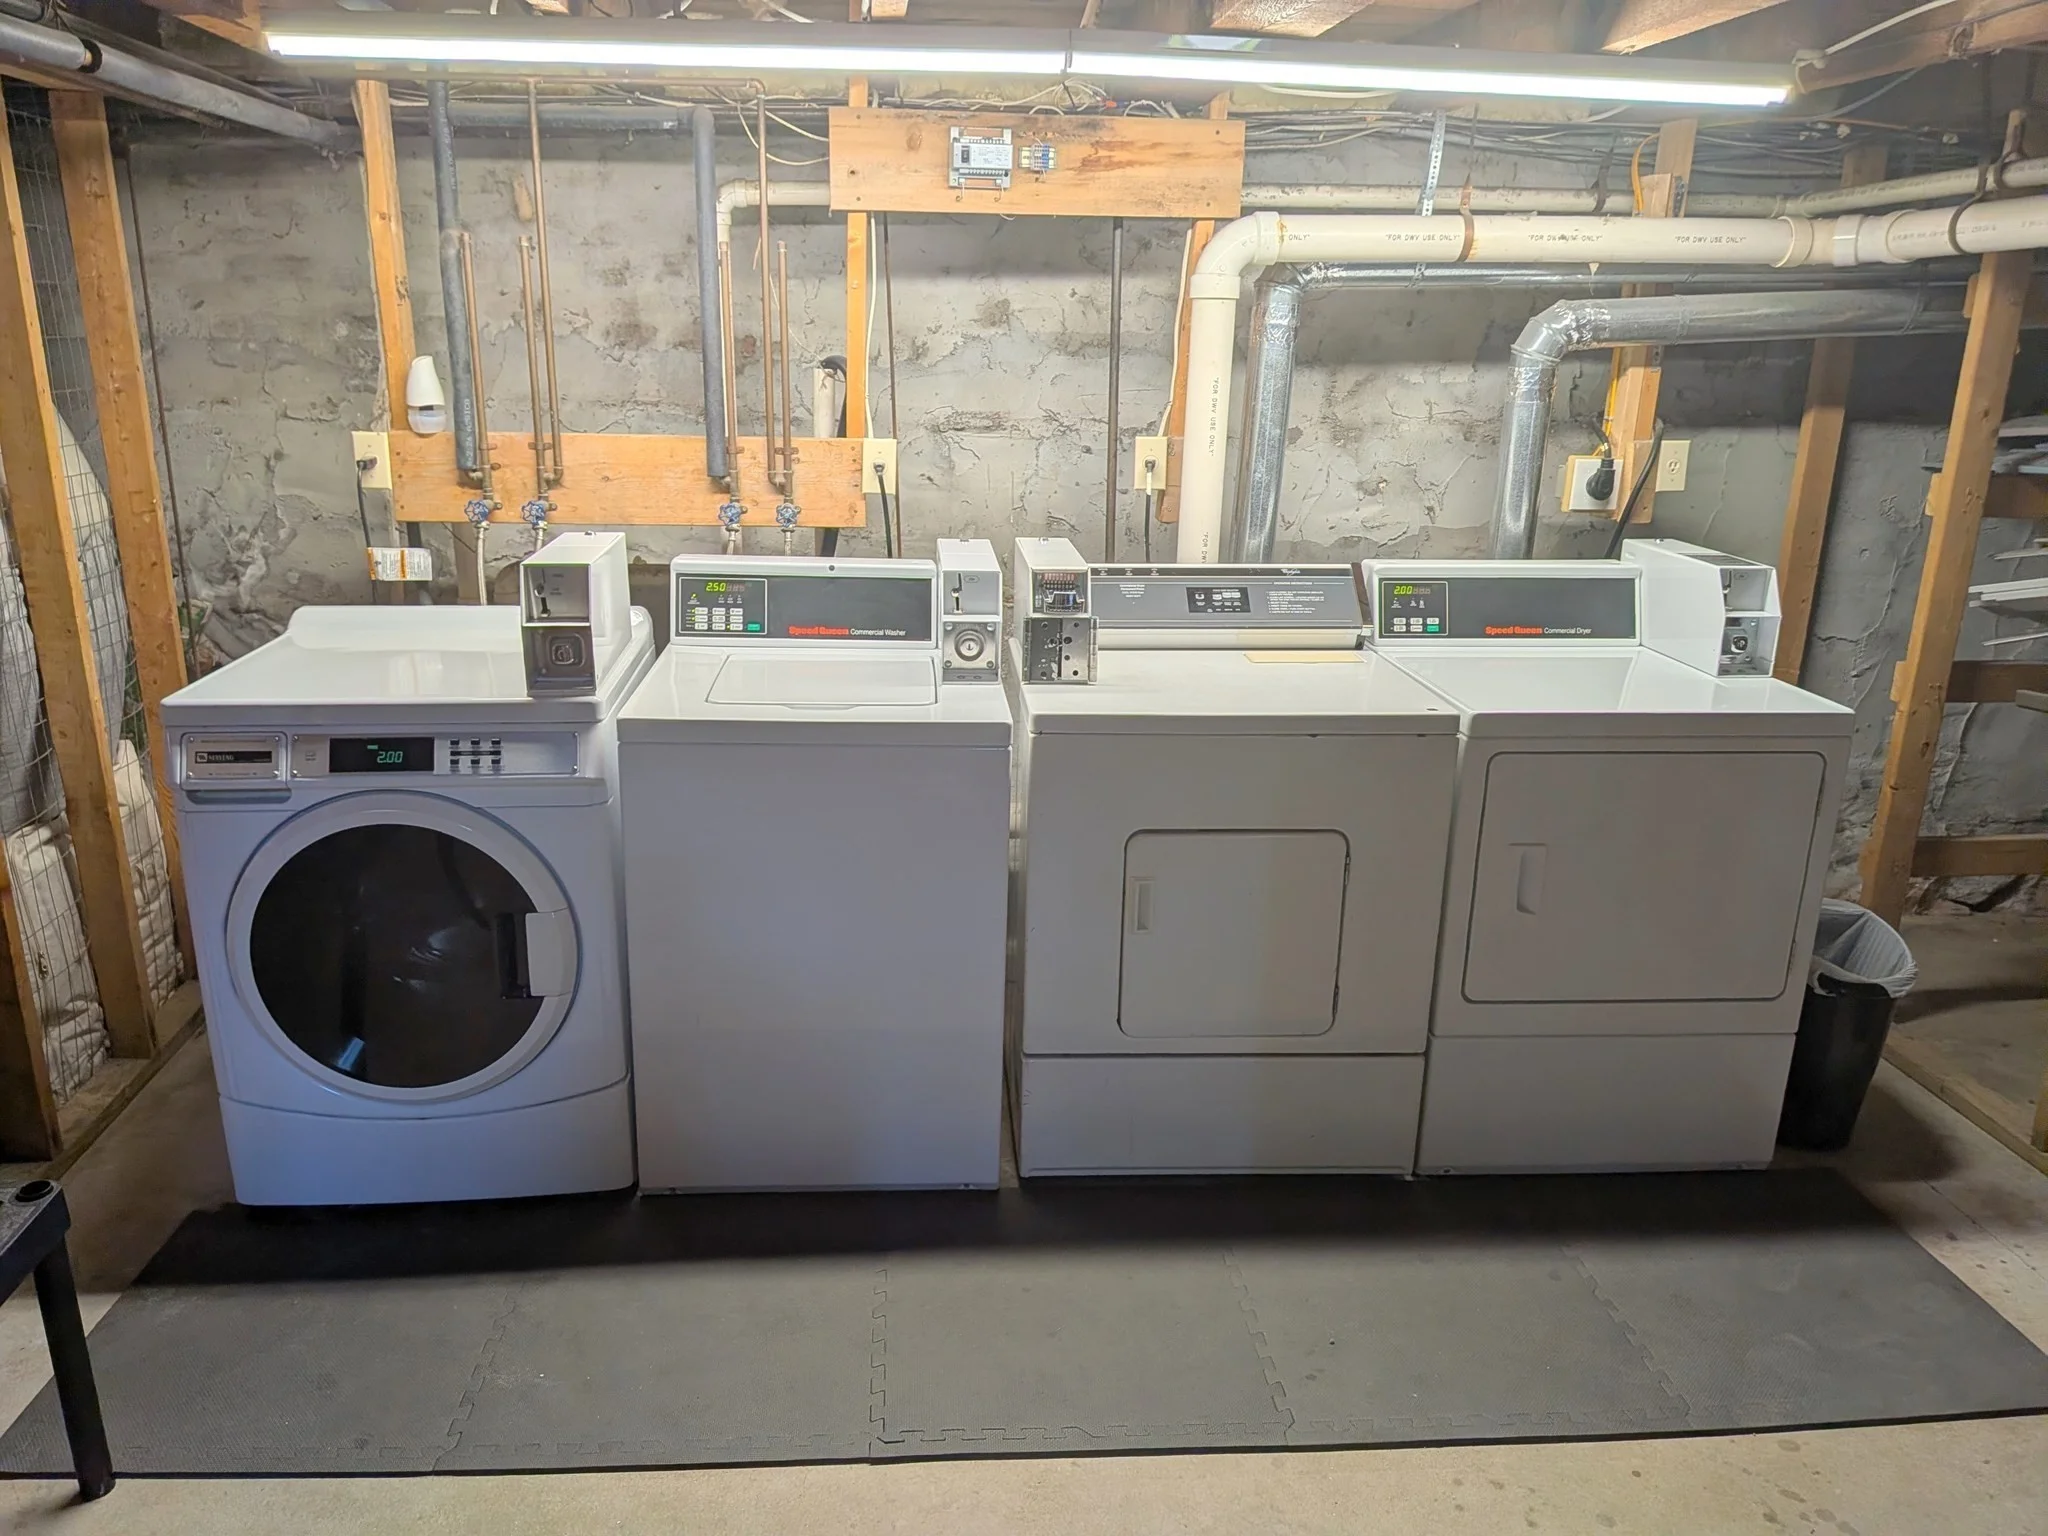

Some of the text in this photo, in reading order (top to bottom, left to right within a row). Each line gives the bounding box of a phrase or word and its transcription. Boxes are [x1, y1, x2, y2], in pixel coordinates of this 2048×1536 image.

[1404, 233, 1420, 241] DWV
[1422, 233, 1436, 241] USE
[1692, 235, 1708, 243] DWV
[1709, 235, 1723, 243] USE
[705, 582, 726, 592] 2.50
[1393, 585, 1413, 595] 2.00
[850, 628, 884, 636] Commercial
[884, 628, 907, 636] Washer
[1485, 626, 1513, 636] Speed
[1514, 626, 1543, 635] Queen
[1576, 627, 1592, 635] Dryer
[376, 751, 403, 764] 2.00
